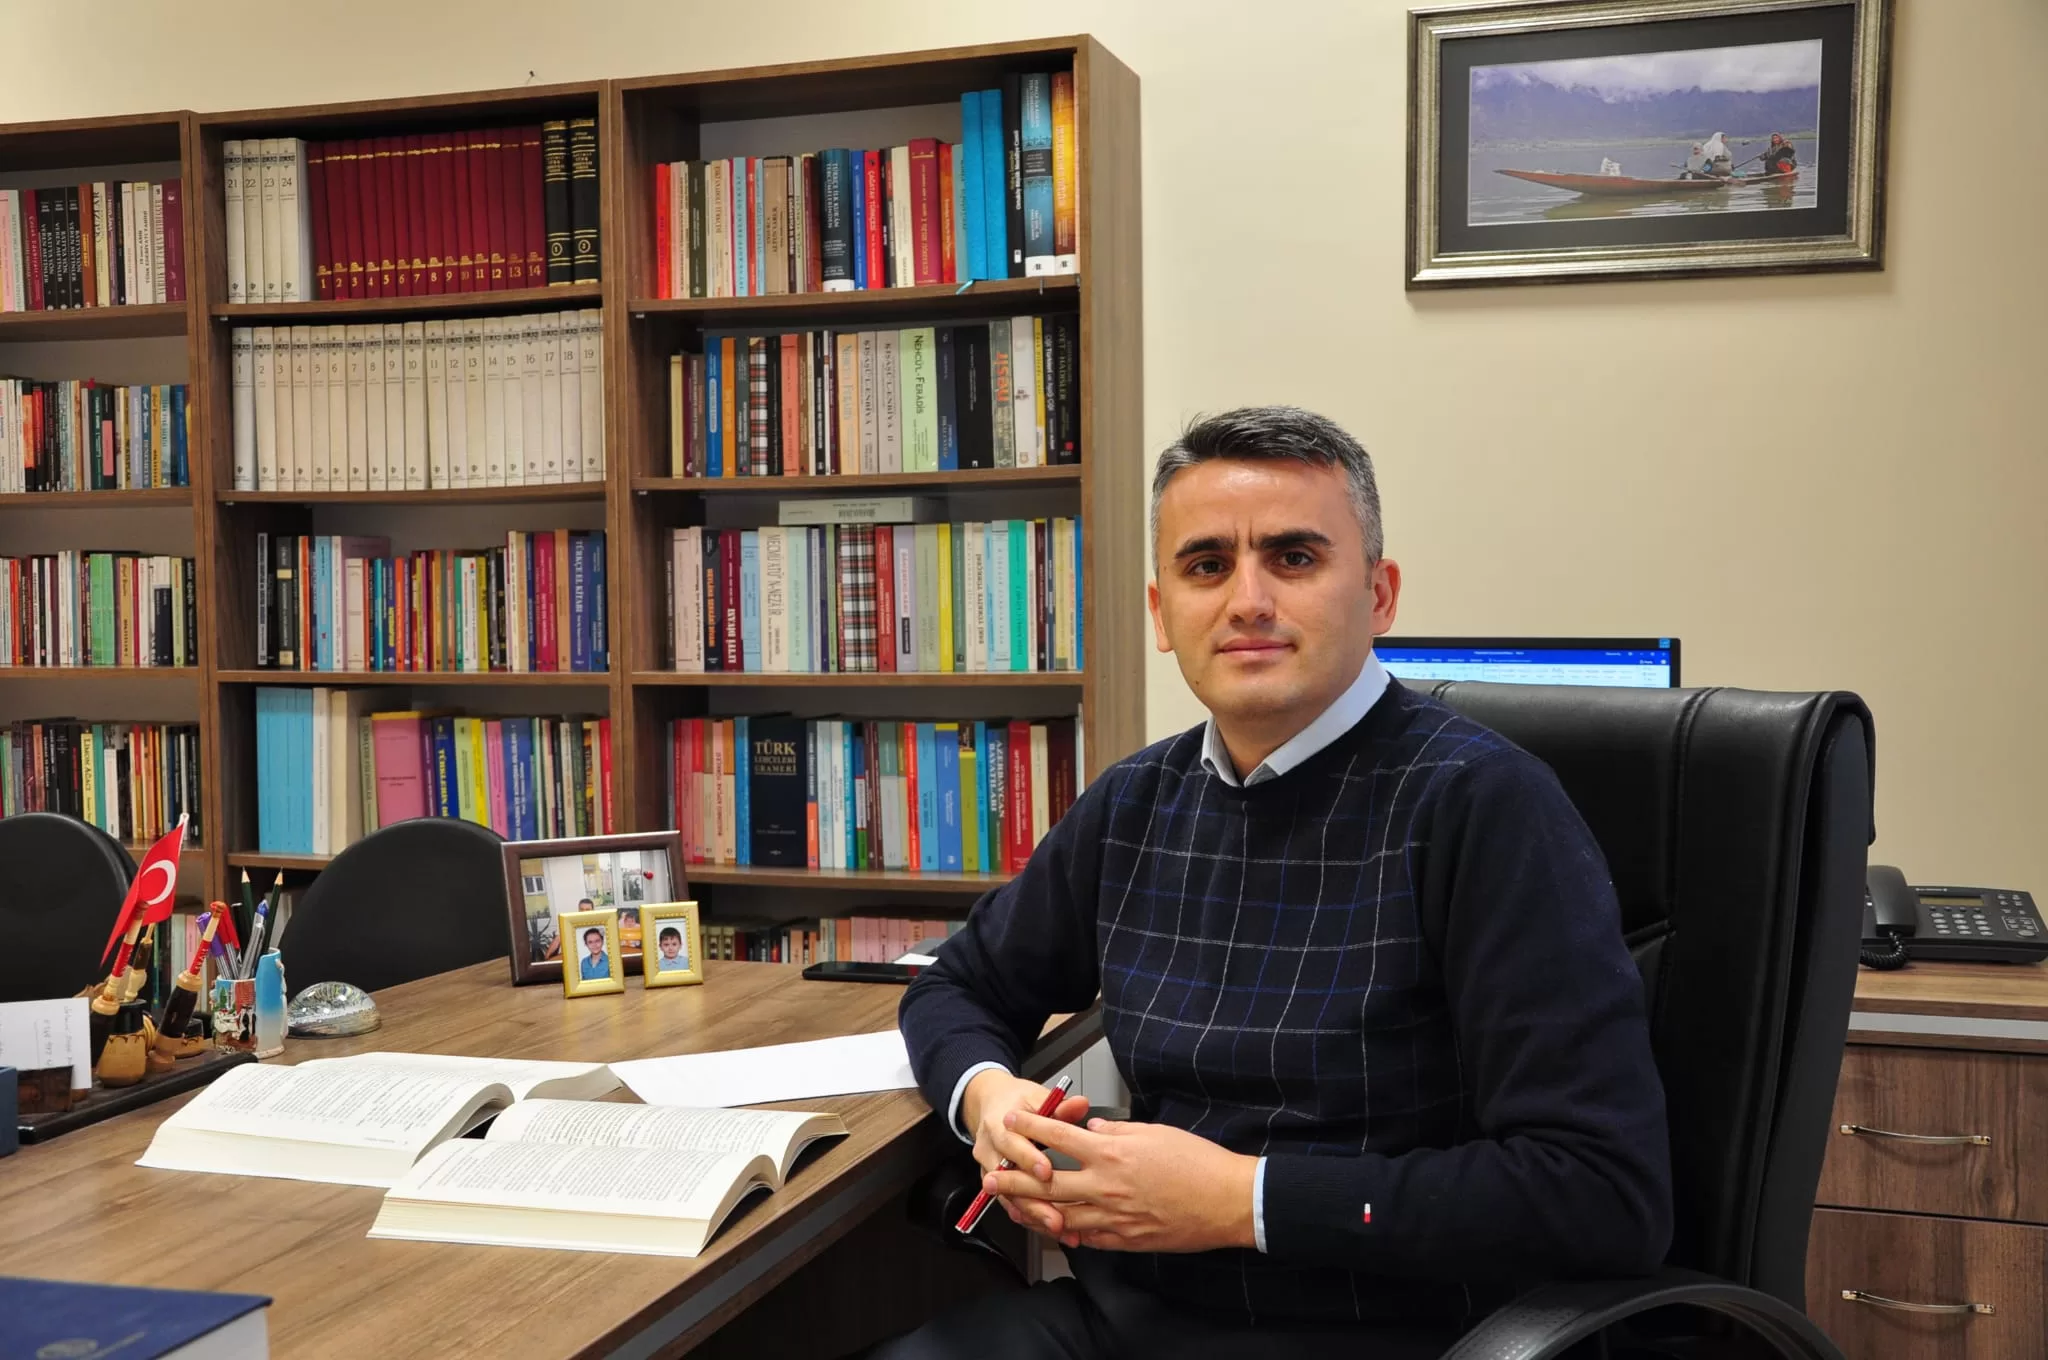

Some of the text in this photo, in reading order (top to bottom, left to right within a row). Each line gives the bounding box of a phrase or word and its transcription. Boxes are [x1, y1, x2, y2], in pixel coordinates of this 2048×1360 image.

[228, 180, 237, 188] 21
[246, 179, 256, 188] 22
[264, 178, 274, 188] 23
[281, 177, 292, 187] 24
[476, 269, 484, 279] 11
[492, 268, 502, 279] 12
[509, 267, 521, 278] 13
[529, 265, 541, 276] 14
[383, 275, 389, 285] 5
[399, 274, 405, 284] 6
[414, 273, 420, 283] 7
[431, 272, 437, 281] 8
[446, 271, 452, 281] 9
[461, 271, 469, 280] 10
[321, 279, 326, 288] 1
[336, 278, 342, 287] 2
[352, 277, 358, 287] 3
[368, 276, 374, 286] 4
[544, 352, 554, 362] 17
[564, 351, 573, 360] 18
[584, 350, 594, 359] 19
[468, 358, 477, 367] 13
[488, 357, 497, 366] 14
[507, 356, 516, 365] 15
[526, 355, 535, 364] 16
[408, 360, 416, 370] 10
[430, 360, 438, 369] 11
[450, 360, 459, 369] 12
[754, 738, 796, 755] TÜRK
[755, 764, 796, 772] GRAMERİ
